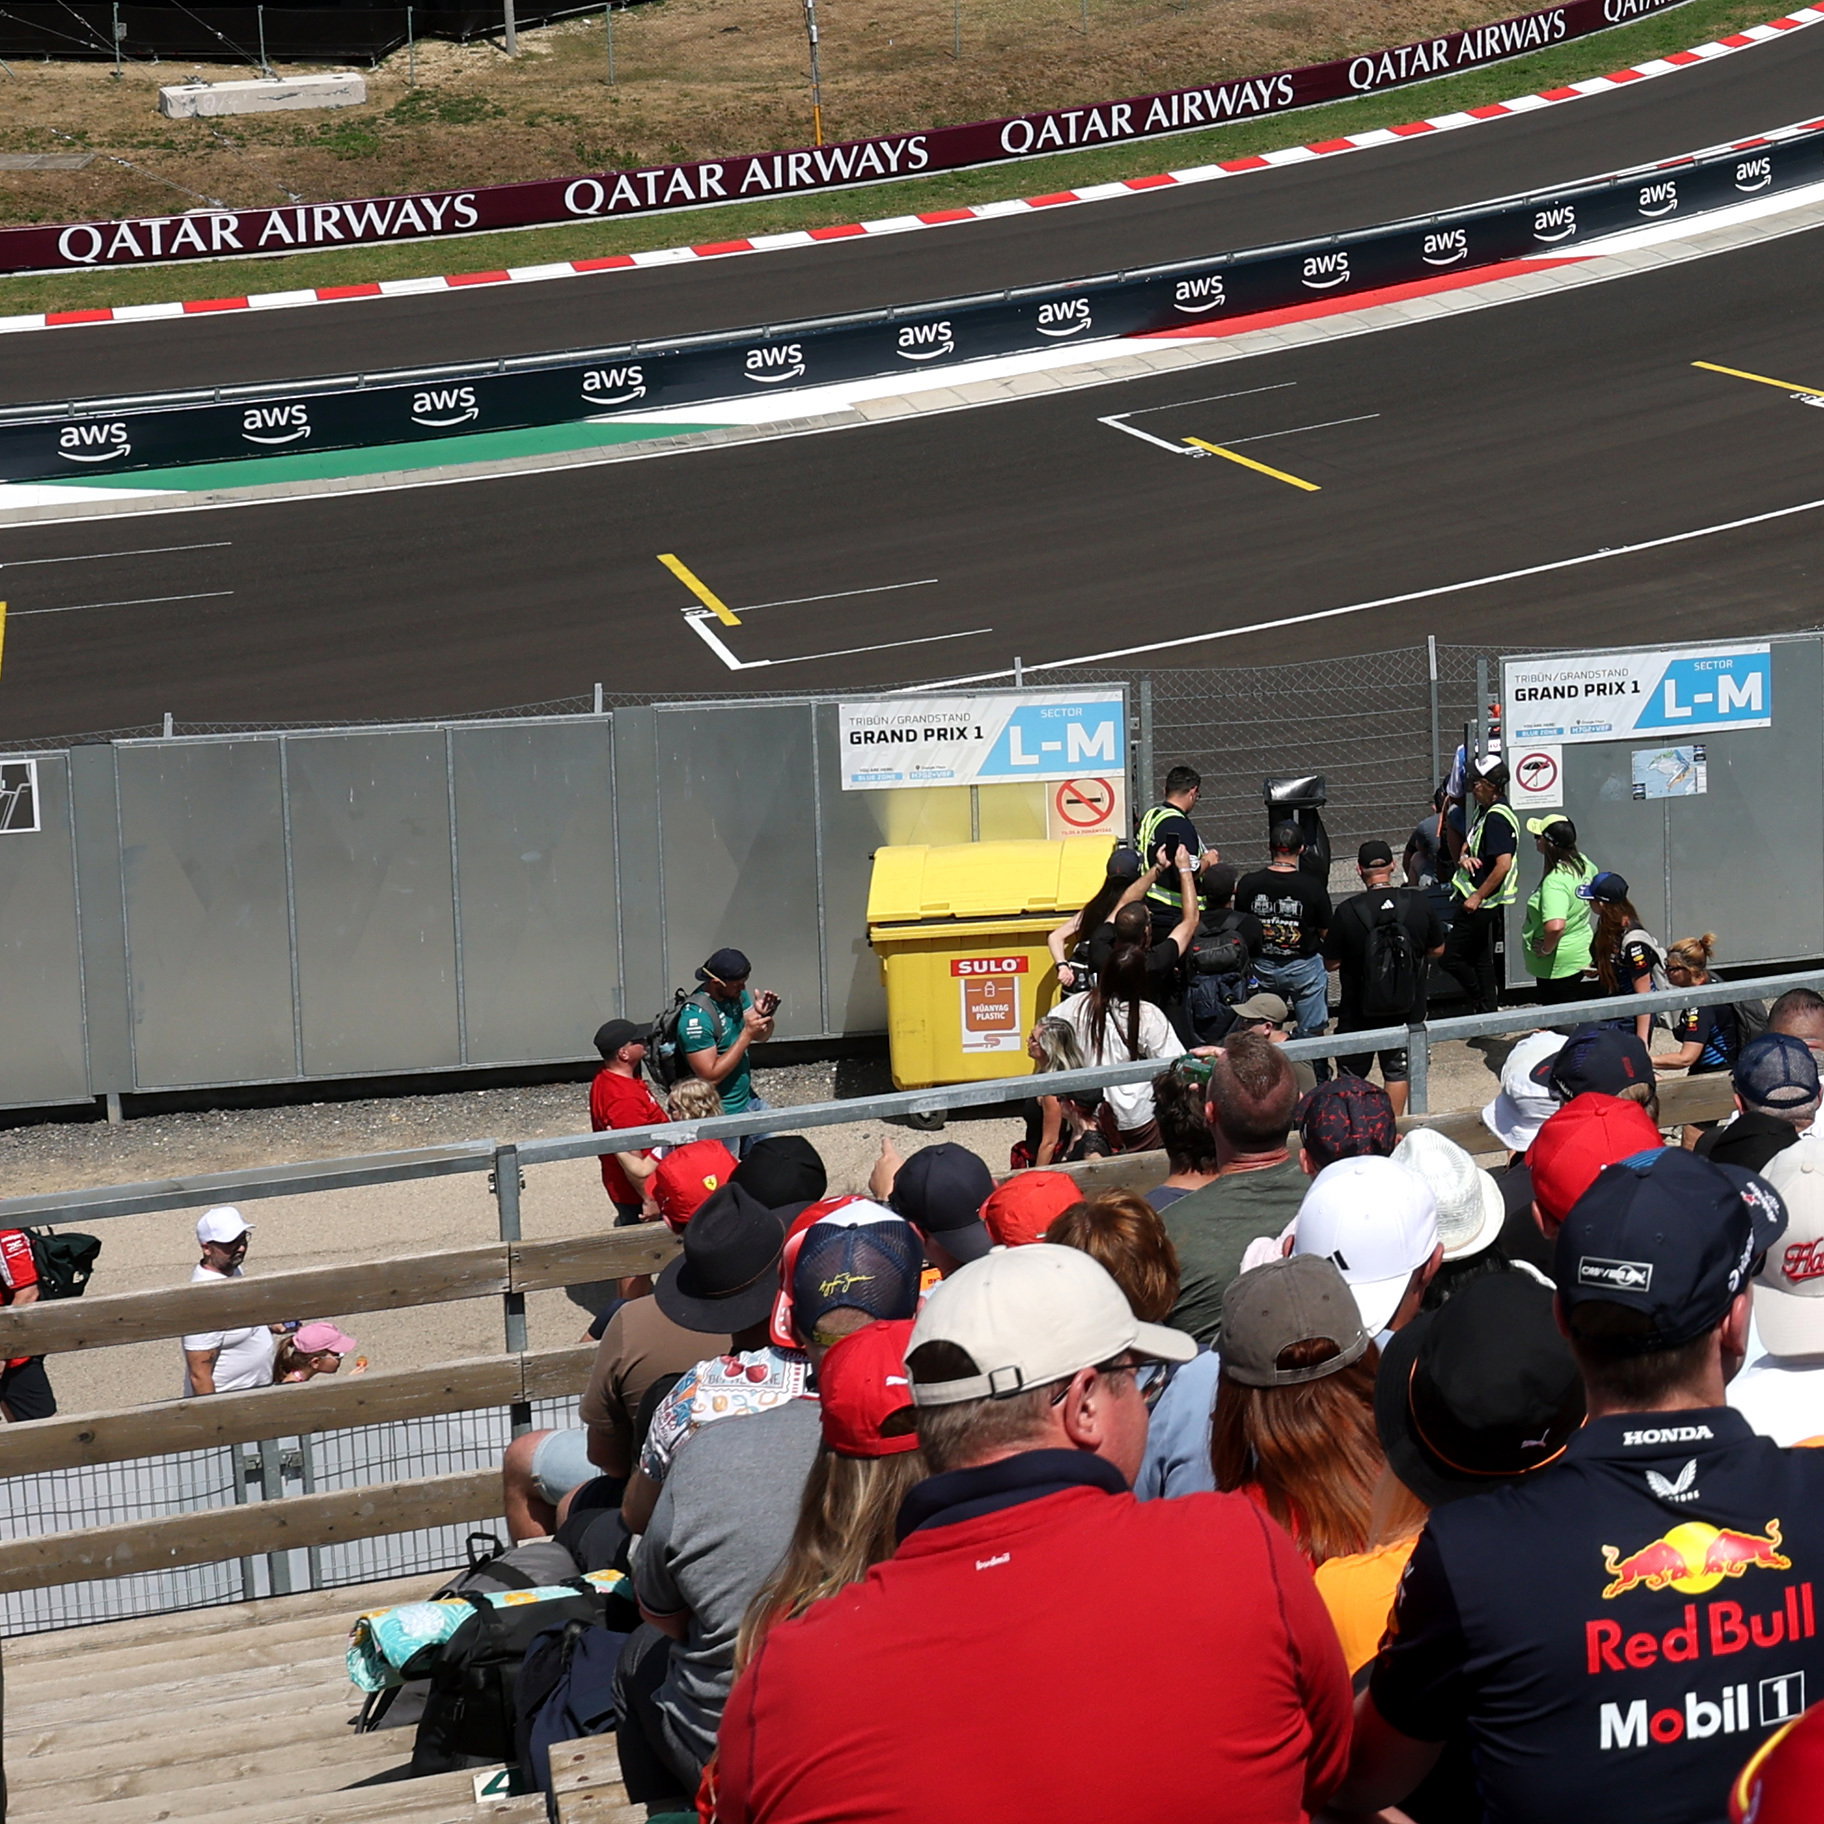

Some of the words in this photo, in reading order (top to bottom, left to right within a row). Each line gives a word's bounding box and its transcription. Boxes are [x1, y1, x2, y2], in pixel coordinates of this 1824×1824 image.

[1348, 41, 1448, 90] QATAR
[1458, 10, 1564, 62] AIRWAYS
[1000, 105, 1131, 154] QATAR
[1145, 74, 1293, 128] AIRWAYS
[565, 163, 728, 215] QATAR
[741, 136, 929, 190] AIRWAYS
[1737, 158, 1771, 183] aws
[58, 208, 244, 264] QATAR
[259, 194, 477, 246] AIRWAYS
[1424, 229, 1466, 254] aws
[898, 322, 952, 347] aws
[413, 387, 476, 412] aws
[59, 423, 127, 448] aws
[1694, 660, 1733, 671] SECTOR
[1515, 684, 1579, 701] GRAND
[1584, 681, 1626, 697] PRIX
[1632, 680, 1640, 693] 1
[1664, 672, 1762, 718] L-M
[1040, 708, 1083, 718] SECTOR
[850, 728, 917, 745] GRAND
[924, 726, 968, 741] PRIX
[974, 726, 984, 739] 1
[1010, 721, 1115, 766] L-M
[958, 959, 1017, 973] SULO
[976, 1012, 1005, 1020] PLASTIC
[1623, 1425, 1713, 1446] HONDA
[1585, 1603, 1699, 1674] Red
[1708, 1582, 1817, 1656] Bull
[1600, 1683, 1750, 1750] Mobil
